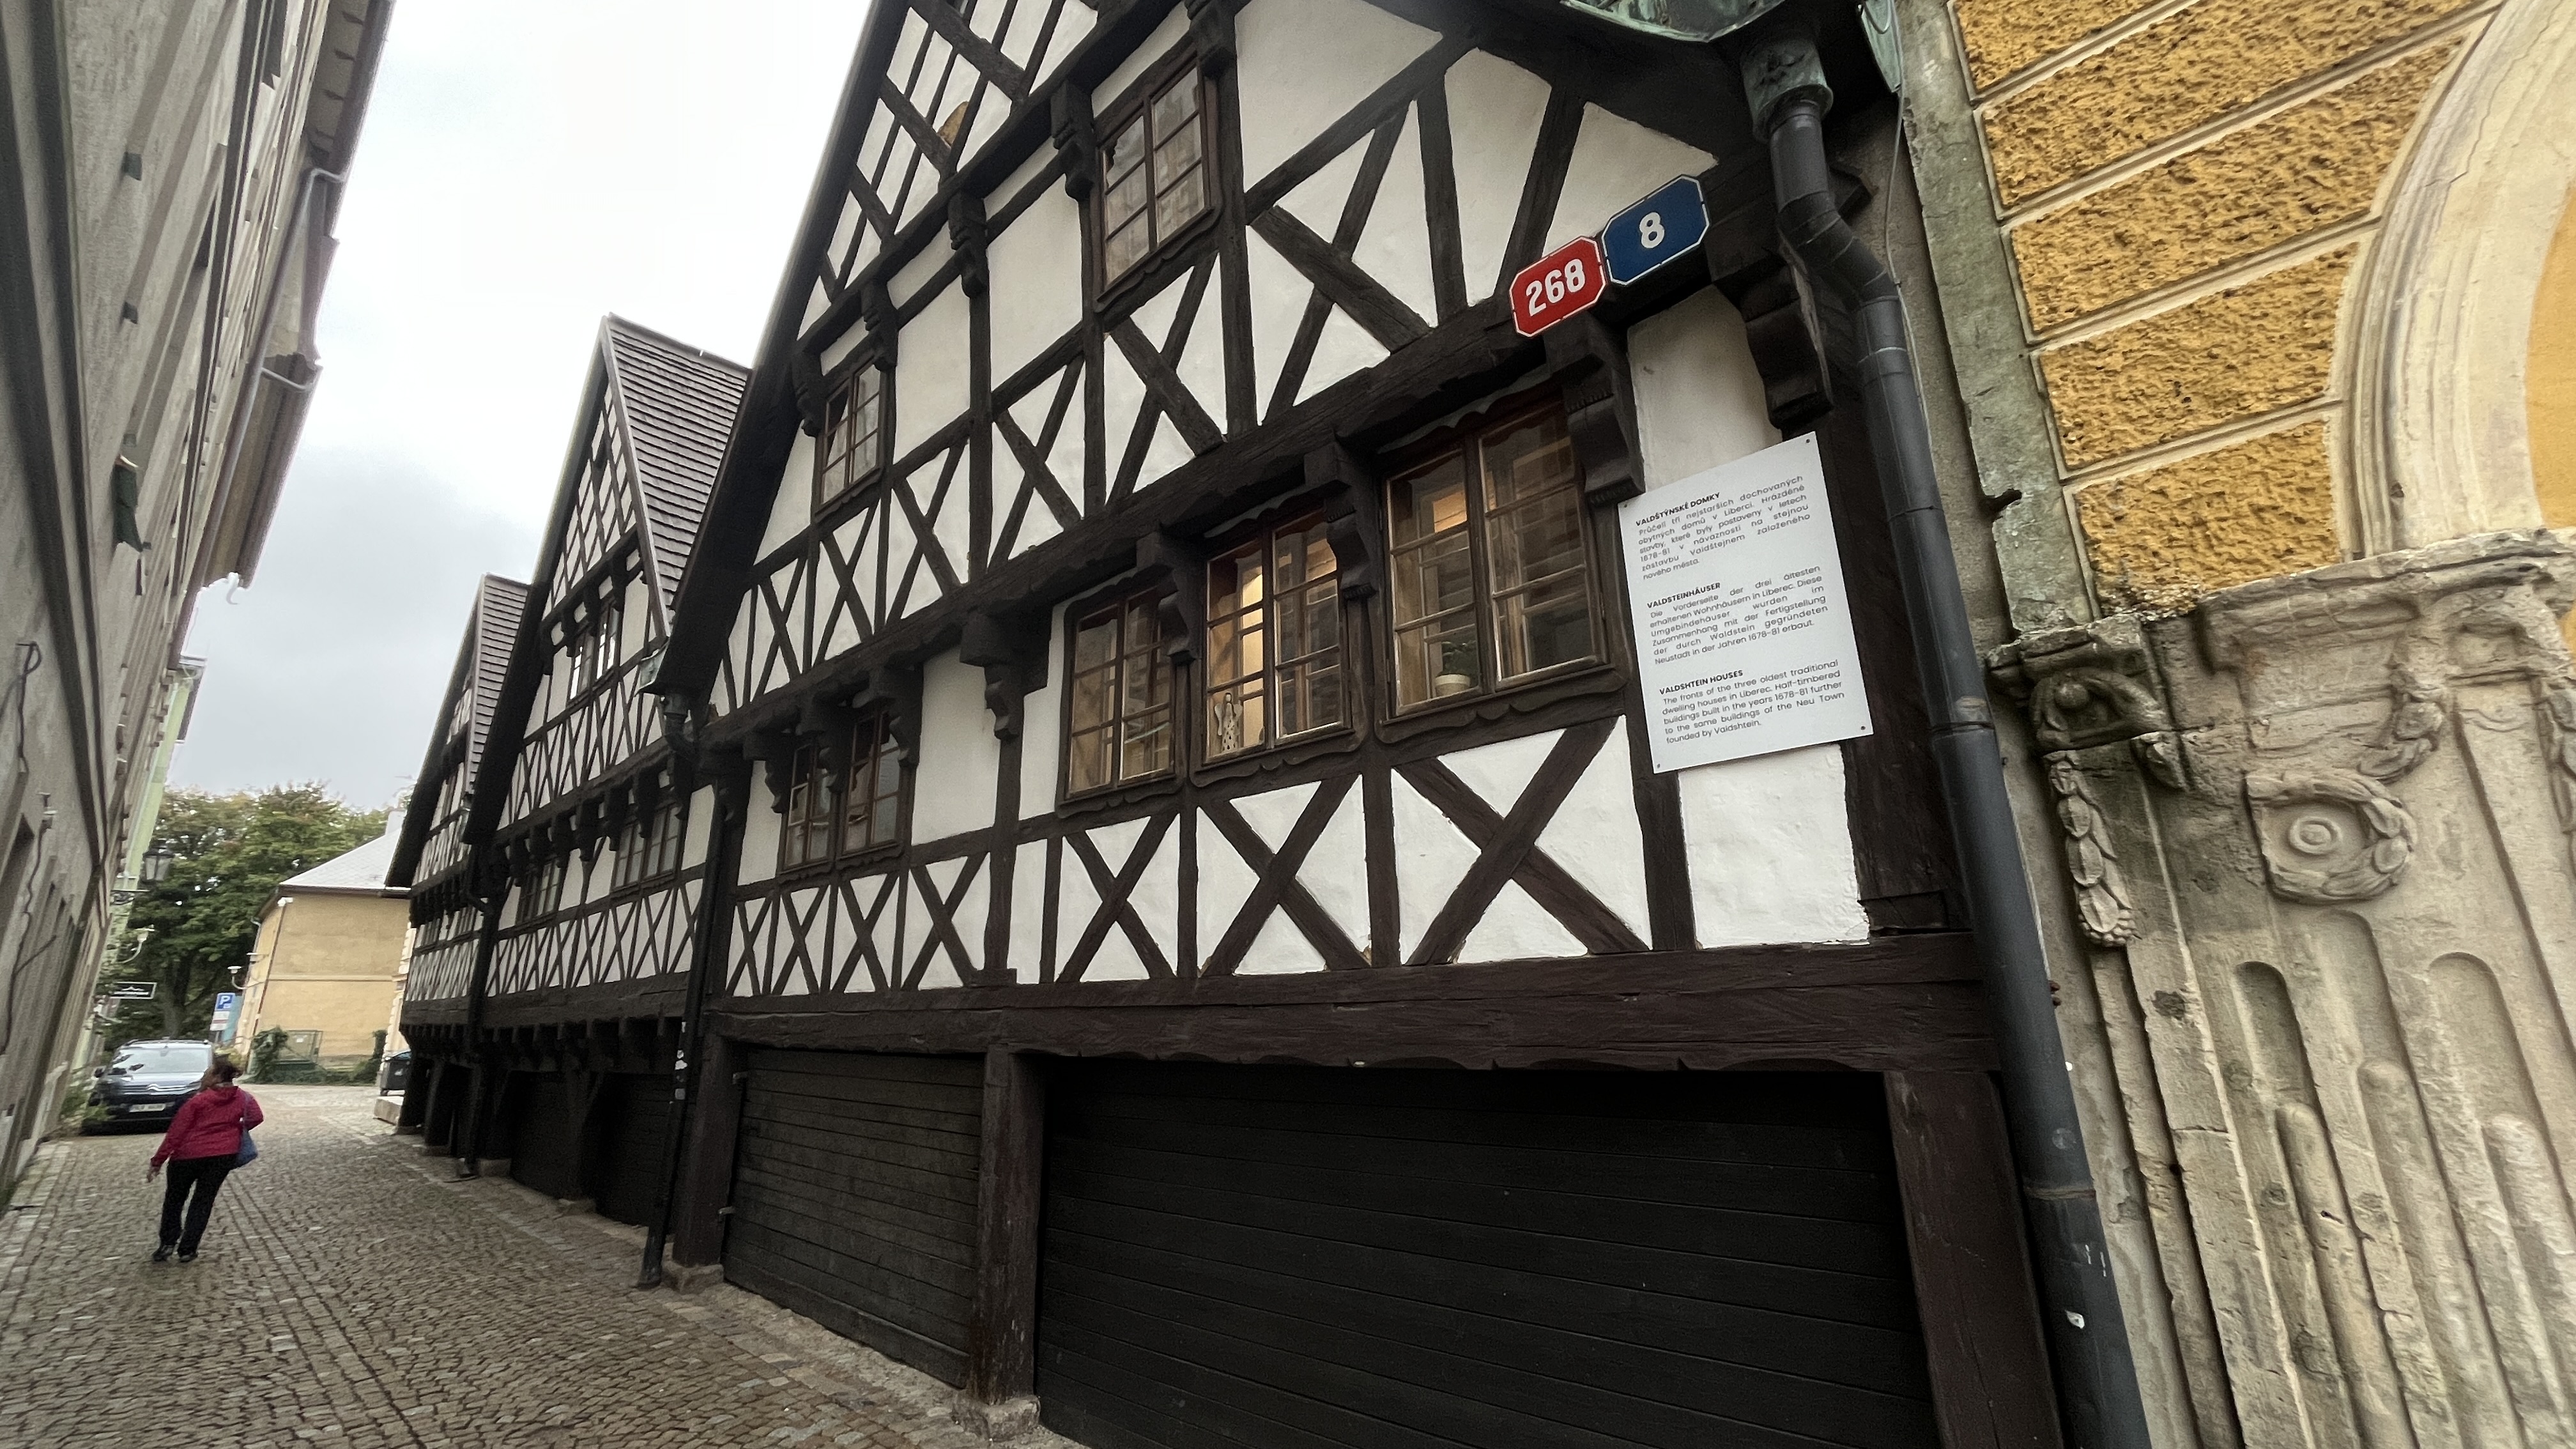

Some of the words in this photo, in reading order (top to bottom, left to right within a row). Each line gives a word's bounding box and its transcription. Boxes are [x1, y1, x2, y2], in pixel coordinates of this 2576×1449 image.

[1639, 211, 1665, 249] 8
[1526, 258, 1586, 317] 268
[1686, 499, 1734, 519] nejstarších
[1739, 476, 1803, 502] dochovaných
[1690, 491, 1720, 508] DOMKY
[1638, 528, 1675, 545] obytných
[1681, 517, 1706, 530] domů
[1671, 532, 1690, 543] které
[1696, 525, 1713, 535] byly
[1718, 509, 1762, 530] postaveny
[1779, 494, 1807, 508] letech
[1751, 519, 1763, 527] na
[1773, 504, 1809, 520] stejnou
[1757, 514, 1811, 535] založeného
[1646, 582, 1721, 609] VALDSTEINHÄUSER
[1650, 612, 1692, 628] erhaltenen
[1693, 595, 1751, 616] Wohnhäusern
[1797, 576, 1822, 588] Diese
[1673, 595, 1719, 611] Vorderseite
[1729, 587, 1744, 596] der
[1754, 578, 1772, 589] drei
[1651, 611, 1730, 637] Umgebindehäuser
[1752, 595, 1788, 610] wurden
[1652, 624, 1719, 647] Zusammenhang
[1724, 618, 1738, 627] mit
[1744, 613, 1759, 622] der
[1765, 595, 1826, 617] Fertigstellung
[1653, 647, 1667, 656] der
[1676, 638, 1701, 650] durch
[1710, 624, 1755, 641] Waldstein
[1655, 650, 1690, 664] Neustadt
[1701, 645, 1715, 653] der
[1717, 637, 1747, 649] Jahren
[1659, 678, 1708, 695] VALDSHTEIN
[1710, 670, 1744, 684] HOUSES
[1662, 703, 1696, 716] dwelling
[1697, 696, 1727, 707] houses
[1774, 670, 1841, 691] Half-timbered
[1680, 691, 1703, 702] fronts
[1706, 687, 1714, 696] of
[1734, 679, 1757, 689] three
[1759, 671, 1788, 684] oldest
[1790, 659, 1839, 677] traditional
[1663, 712, 1700, 724] buildings
[1701, 707, 1720, 717] built
[1732, 702, 1746, 710] the
[1748, 696, 1773, 709] years
[1810, 682, 1842, 694] further
[1693, 718, 1717, 728] same
[1721, 709, 1760, 723] buildings
[1764, 705, 1773, 714] of
[1777, 703, 1792, 711] the
[1819, 692, 1845, 703] Town
[1666, 731, 1700, 744] founded
[219, 995, 231, 1005] P
